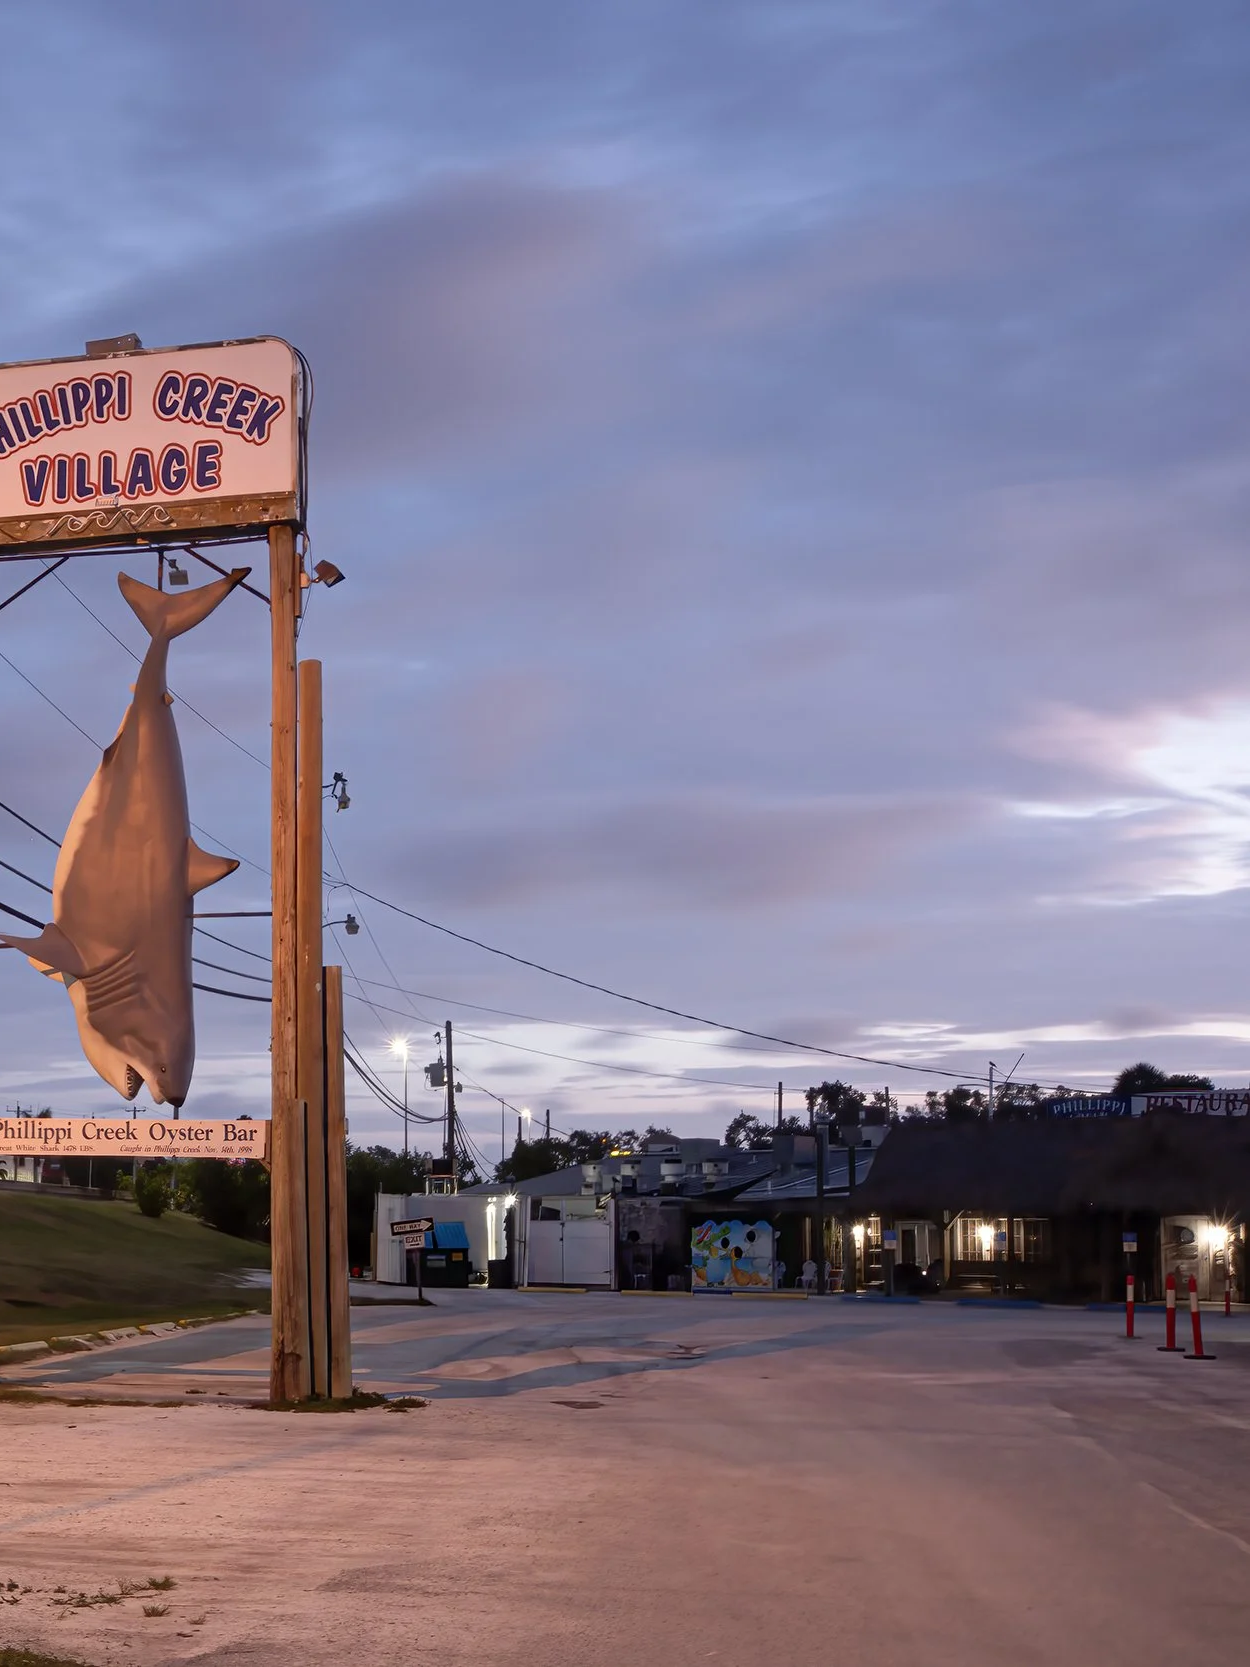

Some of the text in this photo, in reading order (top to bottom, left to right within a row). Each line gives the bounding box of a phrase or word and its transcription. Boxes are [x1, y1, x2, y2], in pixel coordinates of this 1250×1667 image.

[153, 370, 285, 445] CREEK
[20, 439, 223, 507] VILLAGE
[1053, 1099, 1126, 1116] PHILLIPPI
[82, 1121, 138, 1140] Creek
[149, 1122, 213, 1145] Oyster
[223, 1124, 258, 1141] Bar
[120, 1145, 142, 1153] Caught
[183, 1145, 201, 1153] Creek
